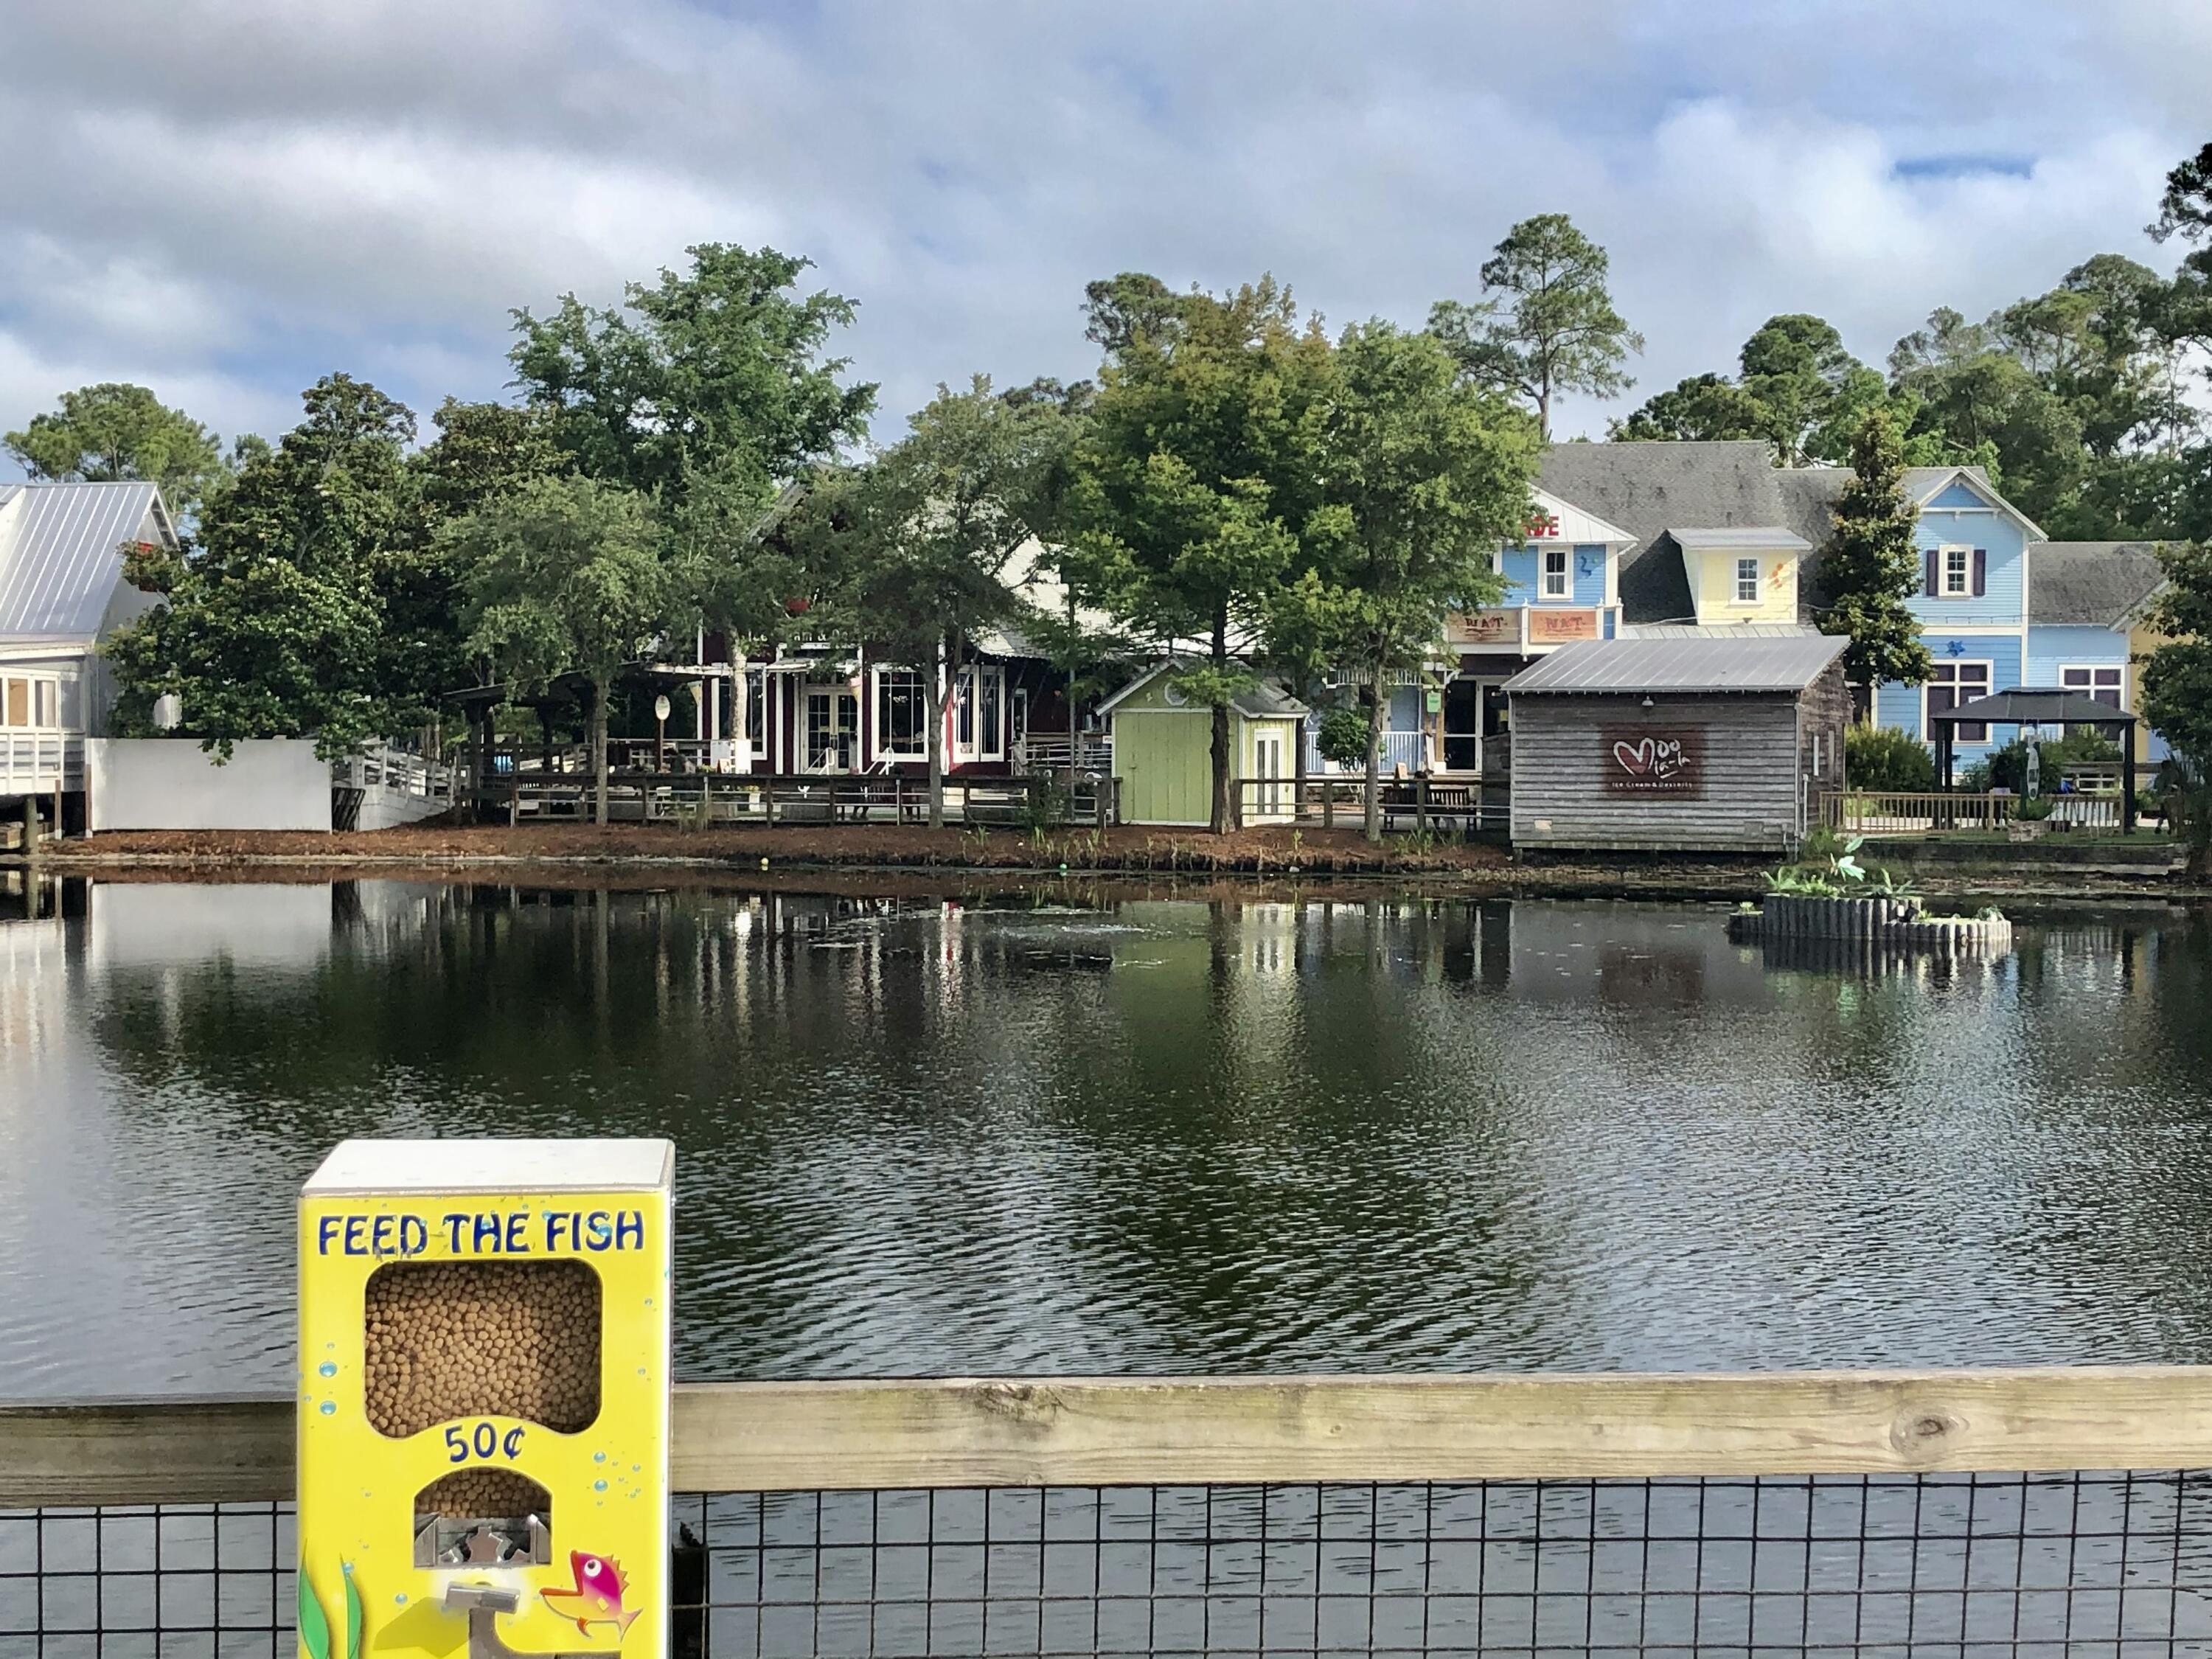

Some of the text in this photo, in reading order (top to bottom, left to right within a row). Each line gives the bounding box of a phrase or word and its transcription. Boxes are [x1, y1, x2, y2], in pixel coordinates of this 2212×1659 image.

[319, 1210, 644, 1255] FEED THE FISH
[445, 1422, 526, 1462] 50¢
